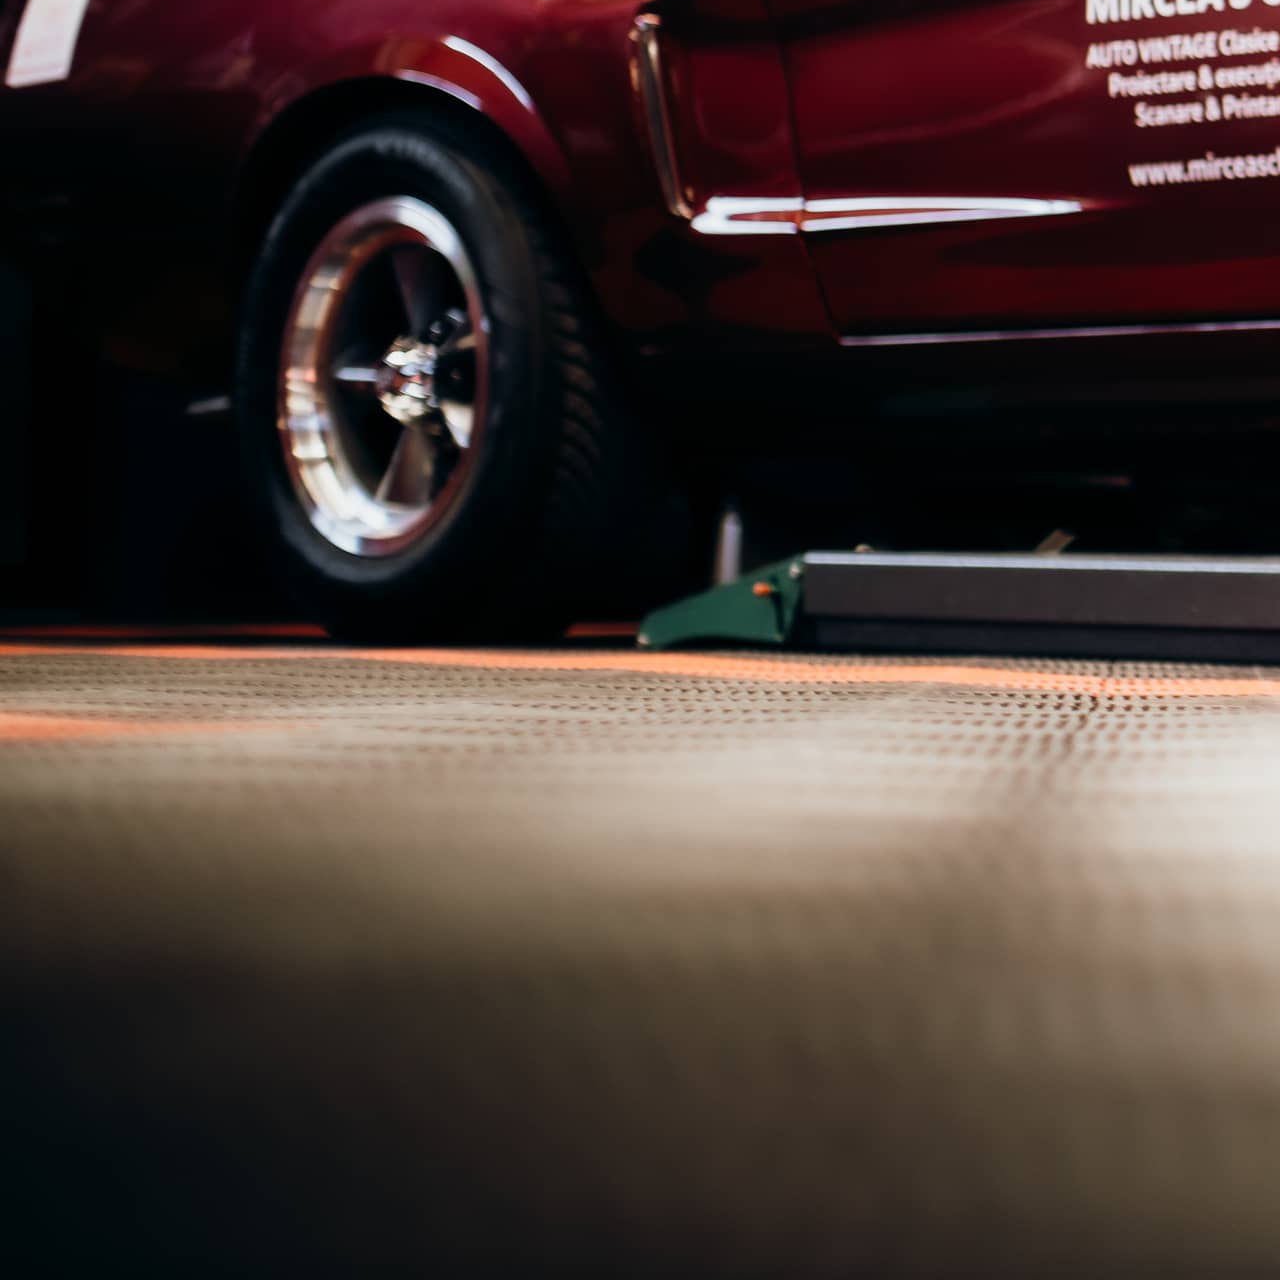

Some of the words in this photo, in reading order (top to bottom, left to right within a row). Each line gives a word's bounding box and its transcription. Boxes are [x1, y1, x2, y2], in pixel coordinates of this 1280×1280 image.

[1085, 38, 1138, 69] AUTO
[1138, 30, 1218, 65] VINTAGE
[1108, 69, 1197, 98] Proiectare
[1197, 63, 1214, 90] &
[1134, 100, 1204, 128] Scanare
[1204, 94, 1221, 122] &
